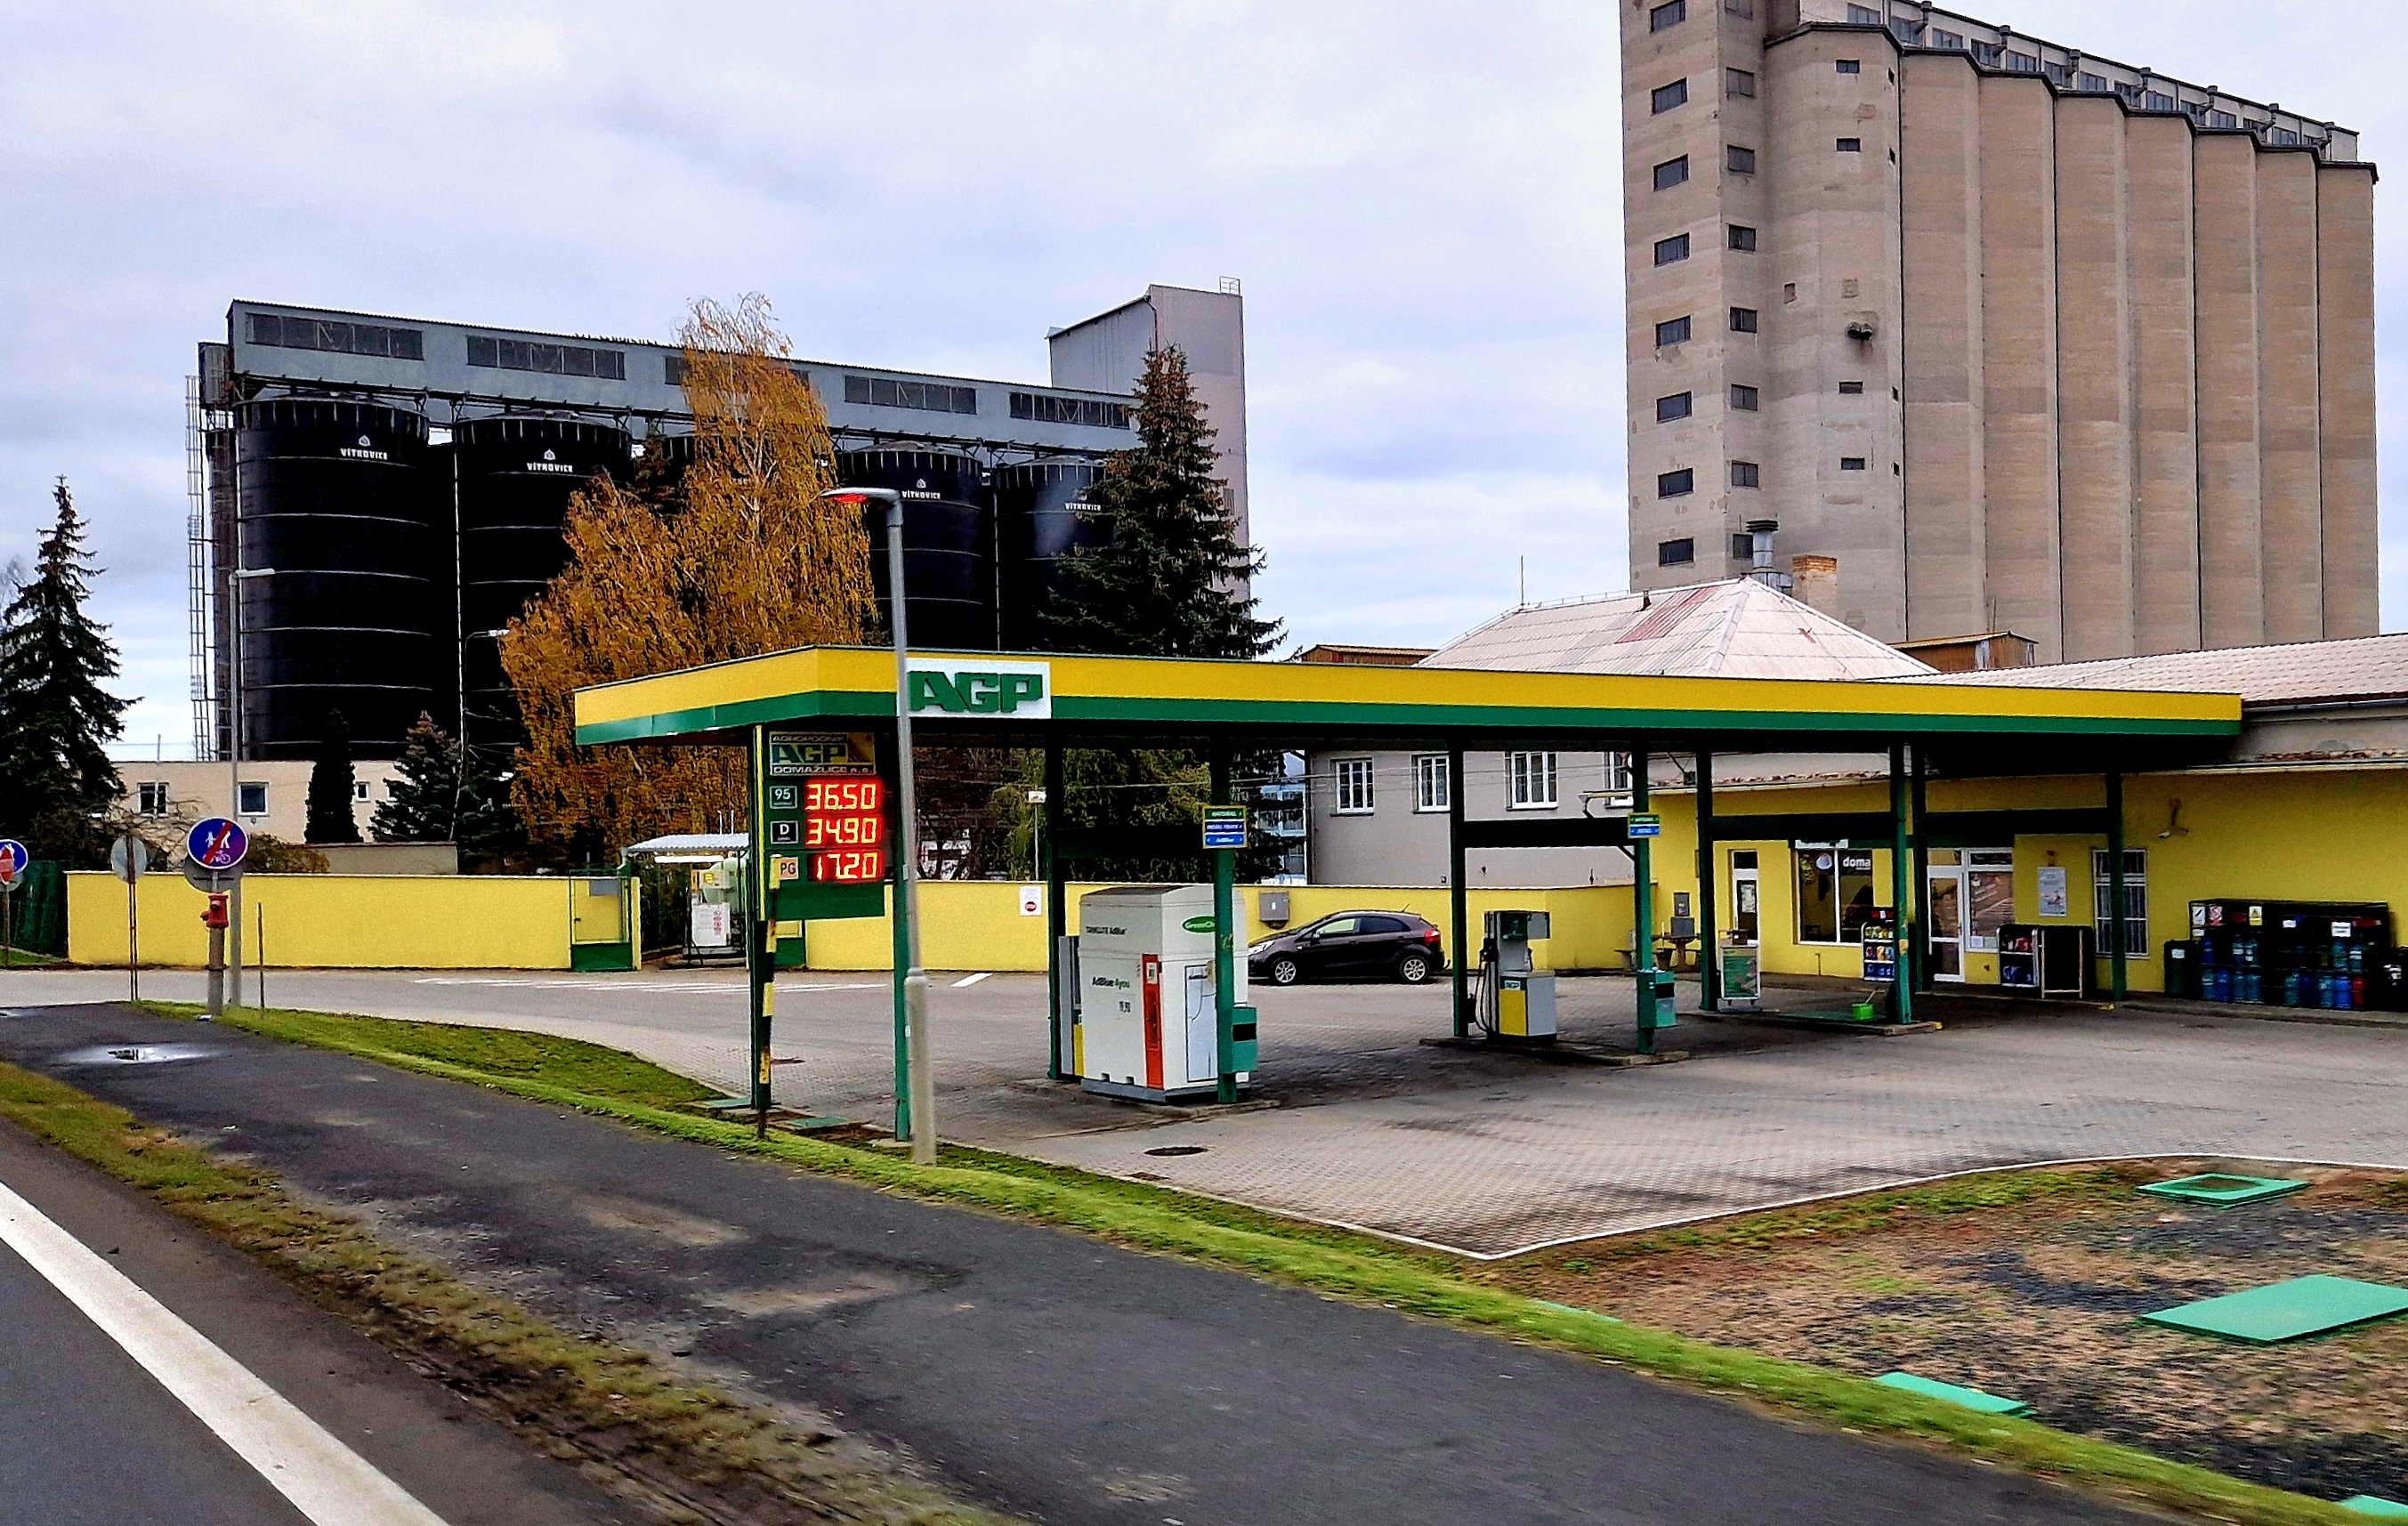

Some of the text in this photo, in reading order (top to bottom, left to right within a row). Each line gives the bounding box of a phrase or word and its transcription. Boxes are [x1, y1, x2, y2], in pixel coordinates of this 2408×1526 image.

[909, 670, 1043, 713] AGP
[772, 745, 846, 763] AGP
[774, 788, 791, 800] 95
[780, 824, 790, 836] D
[1842, 856, 1871, 868] doma
[780, 862, 796, 875] PG
